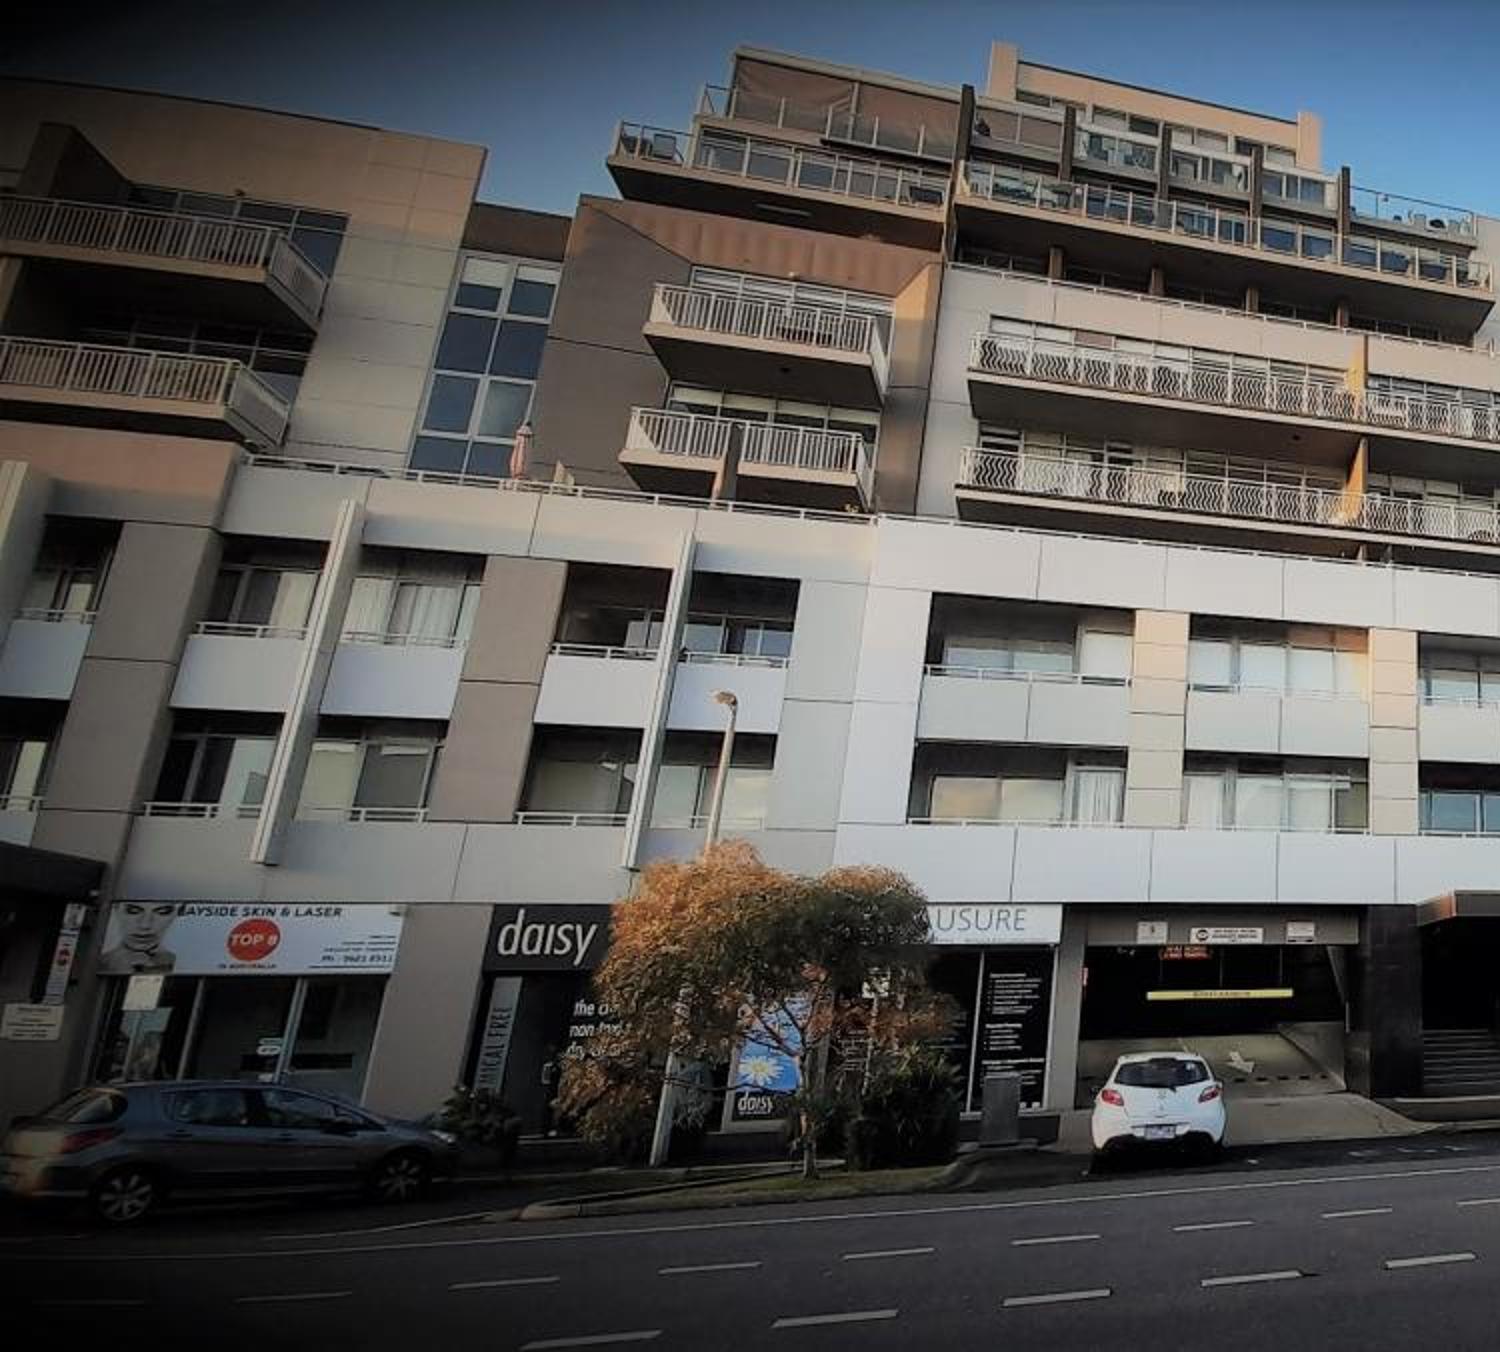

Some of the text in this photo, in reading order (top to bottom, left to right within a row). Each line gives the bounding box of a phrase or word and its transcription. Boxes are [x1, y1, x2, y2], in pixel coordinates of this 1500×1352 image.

[241, 905, 277, 917] SKIN
[294, 905, 343, 917] LASER
[231, 932, 265, 947] TOP
[497, 908, 598, 966] daisy
[487, 1007, 512, 1038] FREE
[737, 1091, 774, 1113] daisy
